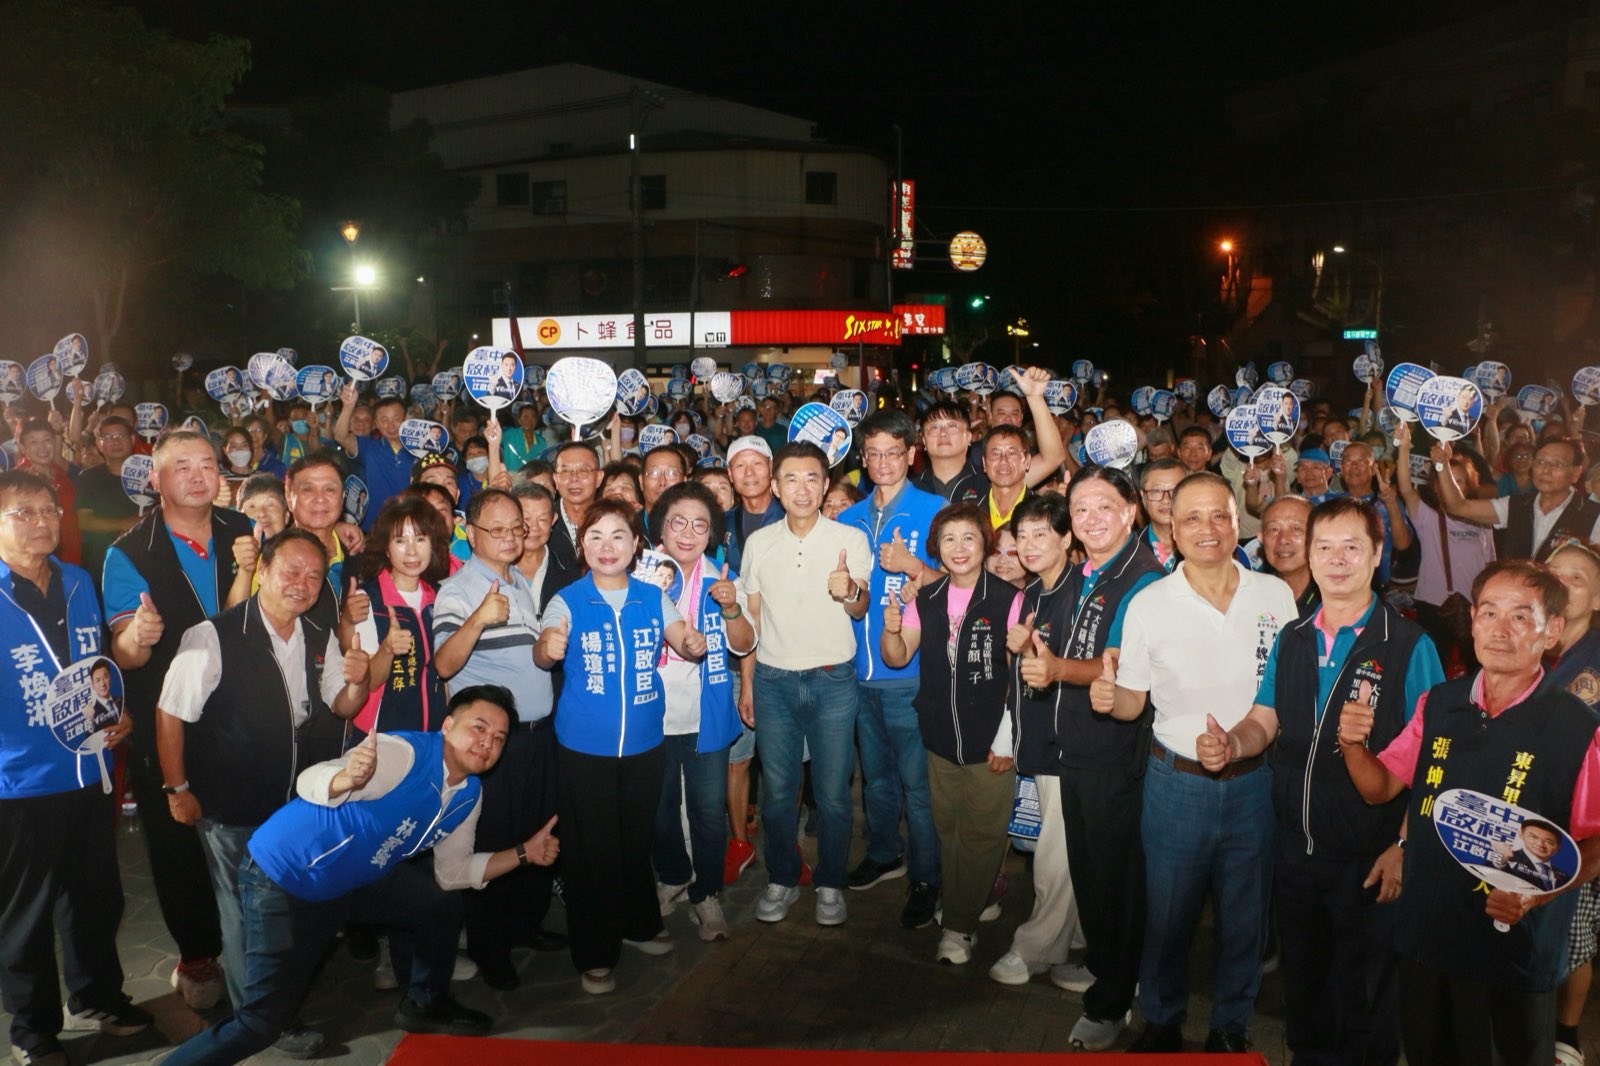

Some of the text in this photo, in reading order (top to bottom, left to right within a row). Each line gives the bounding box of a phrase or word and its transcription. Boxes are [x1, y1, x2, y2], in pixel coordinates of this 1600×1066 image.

[539, 326, 558, 339] CP
[843, 314, 866, 340] SIX
[604, 632, 616, 673] 立法委員
[633, 628, 654, 692] 江啟臣
[704, 612, 726, 673] 江啟臣
[54, 665, 92, 699] 臺中
[51, 688, 92, 725] 啟程
[1419, 736, 1451, 818] 張坤山
[1439, 805, 1518, 844] 啟程
[1454, 789, 1526, 823] 臺中
[1452, 838, 1503, 865] 江啟臣
